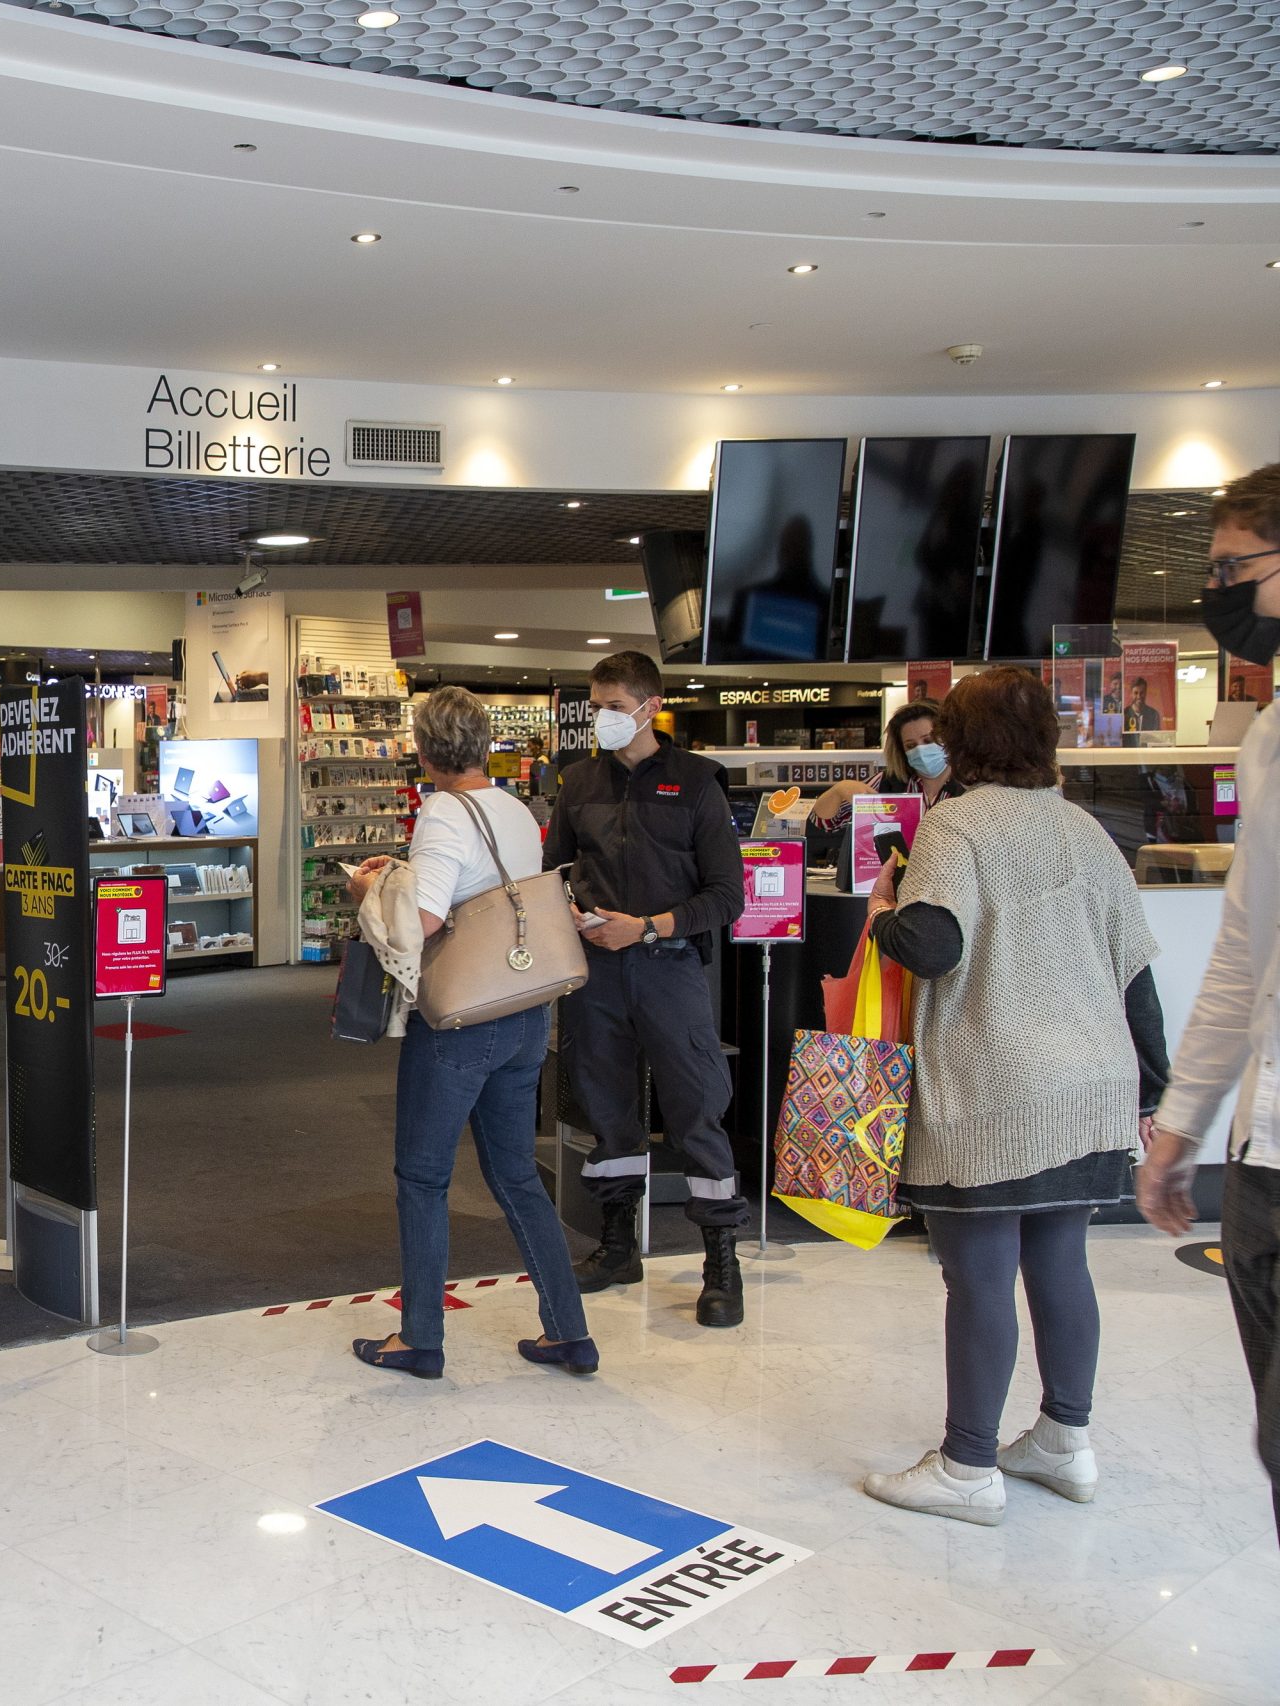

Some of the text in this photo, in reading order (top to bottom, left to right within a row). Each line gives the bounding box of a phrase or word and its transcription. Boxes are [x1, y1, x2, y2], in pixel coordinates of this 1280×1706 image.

[147, 374, 297, 422] Accueil
[145, 427, 330, 476] Billetterie
[1142, 655, 1175, 663] PASSIONS
[720, 688, 830, 705] ESPACE SERVICE
[0, 697, 60, 727] DEVENEZ
[560, 701, 594, 724] DEVE
[1, 724, 75, 757] ADHÉRENT
[560, 720, 595, 750] ADHÉ
[6, 869, 73, 893] CARTE FNAC
[22, 894, 54, 915] 3 ANS
[598, 1538, 785, 1631] ENTRÉE
